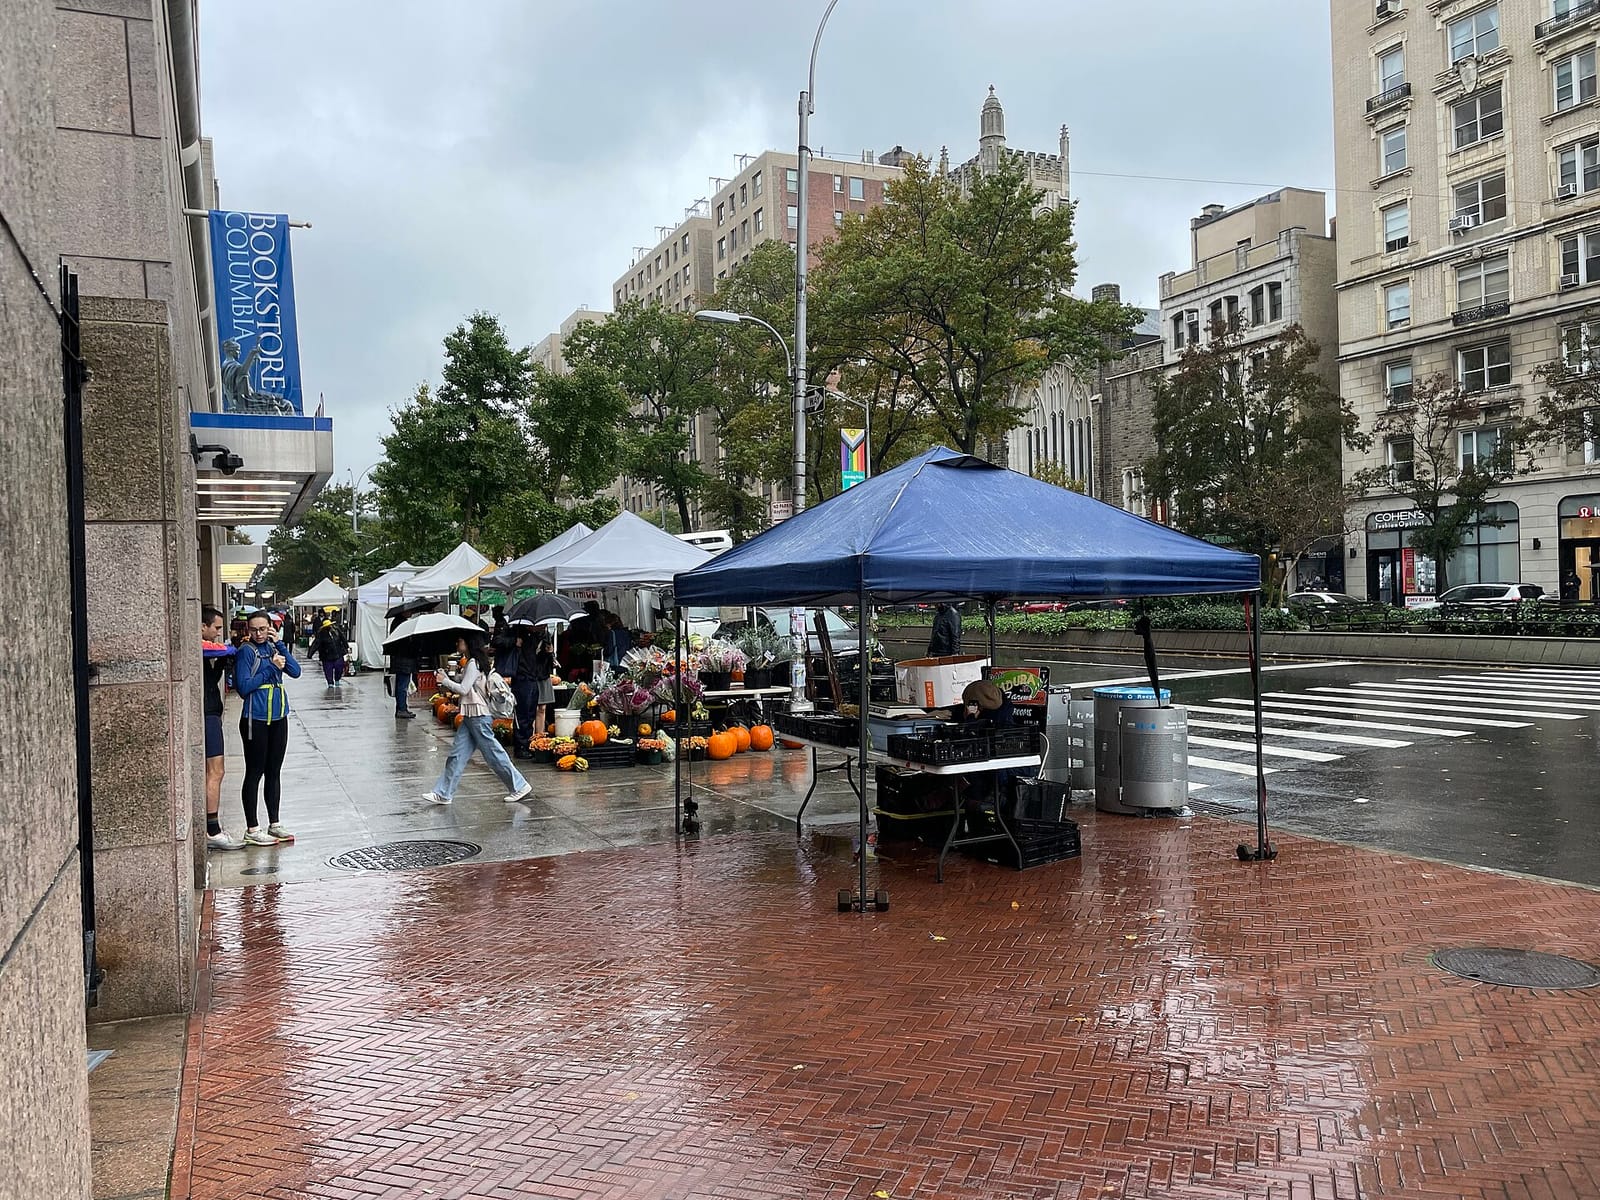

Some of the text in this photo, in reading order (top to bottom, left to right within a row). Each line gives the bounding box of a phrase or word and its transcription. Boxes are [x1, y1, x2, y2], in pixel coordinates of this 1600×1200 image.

[224, 211, 255, 340] COLUMBIA
[248, 214, 286, 388] BOOKSTORE
[1374, 509, 1425, 522] COHEN'S
